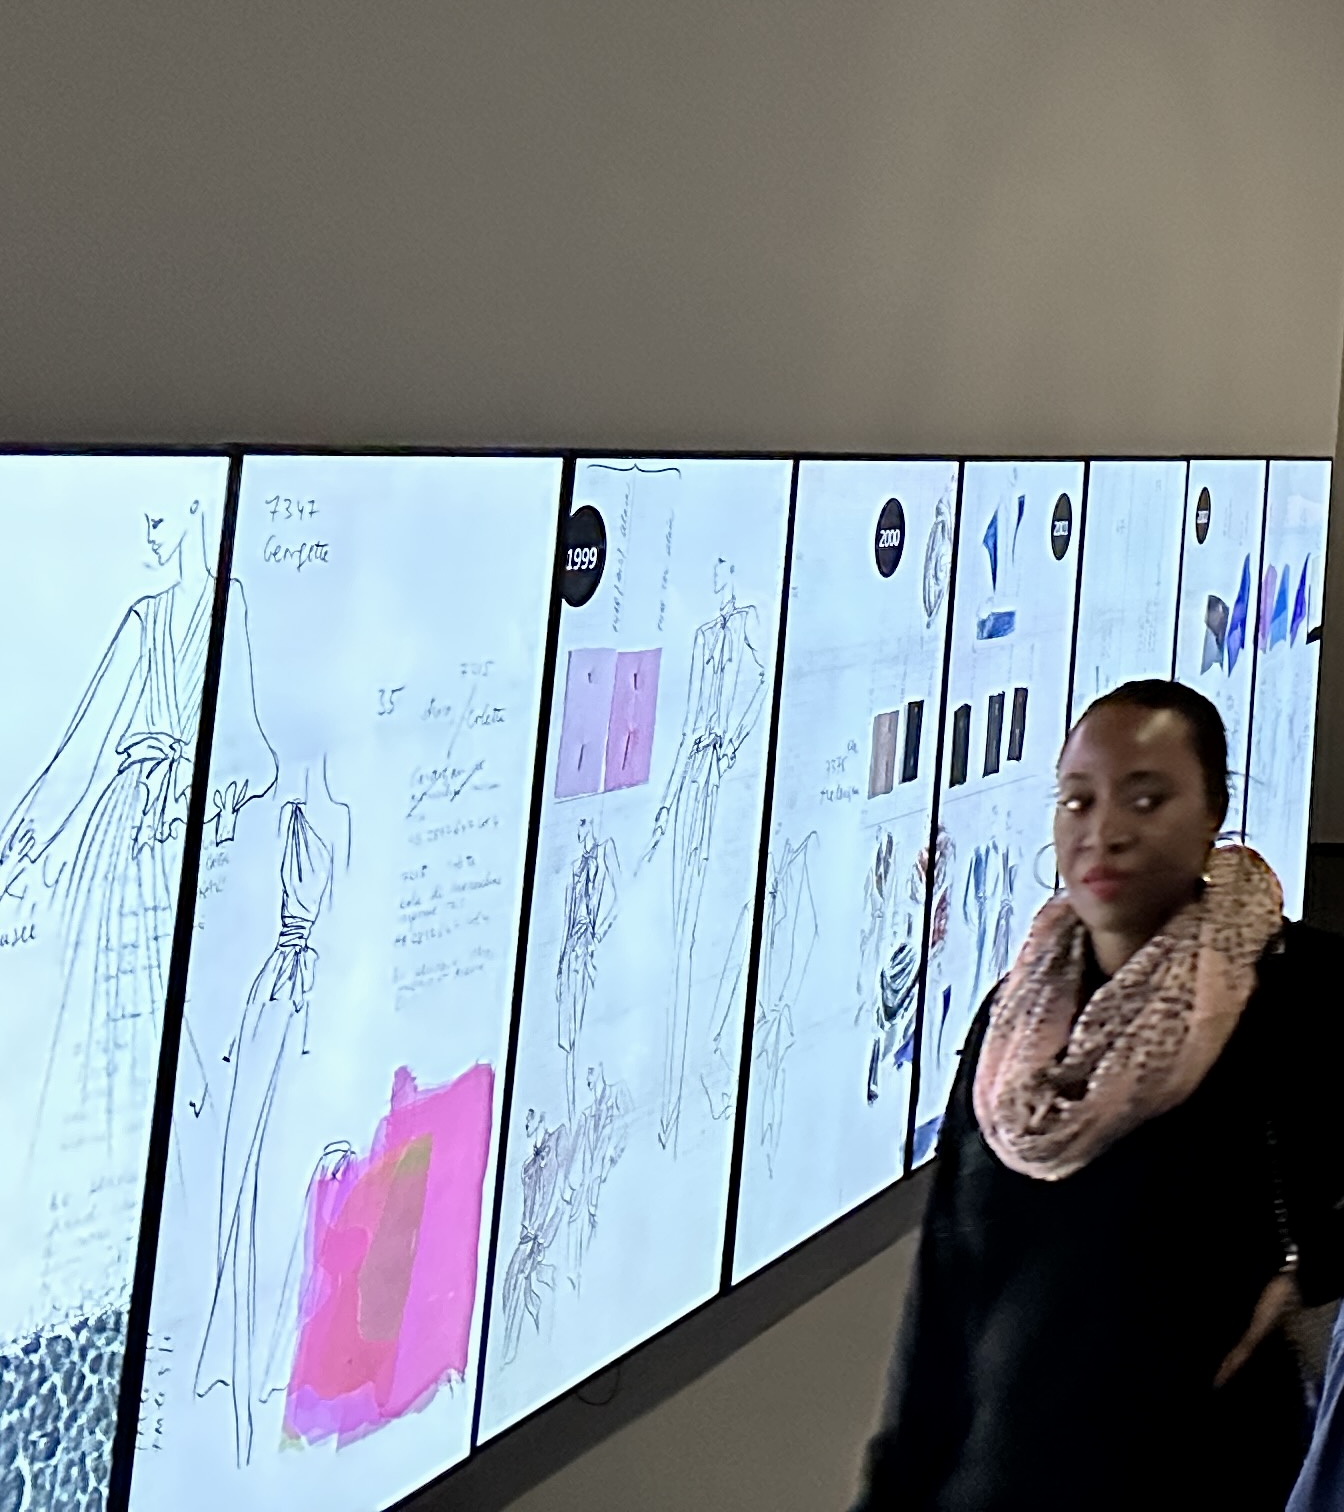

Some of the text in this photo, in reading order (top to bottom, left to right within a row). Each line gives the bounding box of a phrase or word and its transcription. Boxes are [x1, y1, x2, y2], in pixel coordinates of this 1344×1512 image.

[265, 495, 319, 522] 7347
[879, 529, 900, 548] 2000
[566, 547, 598, 571] 1999
